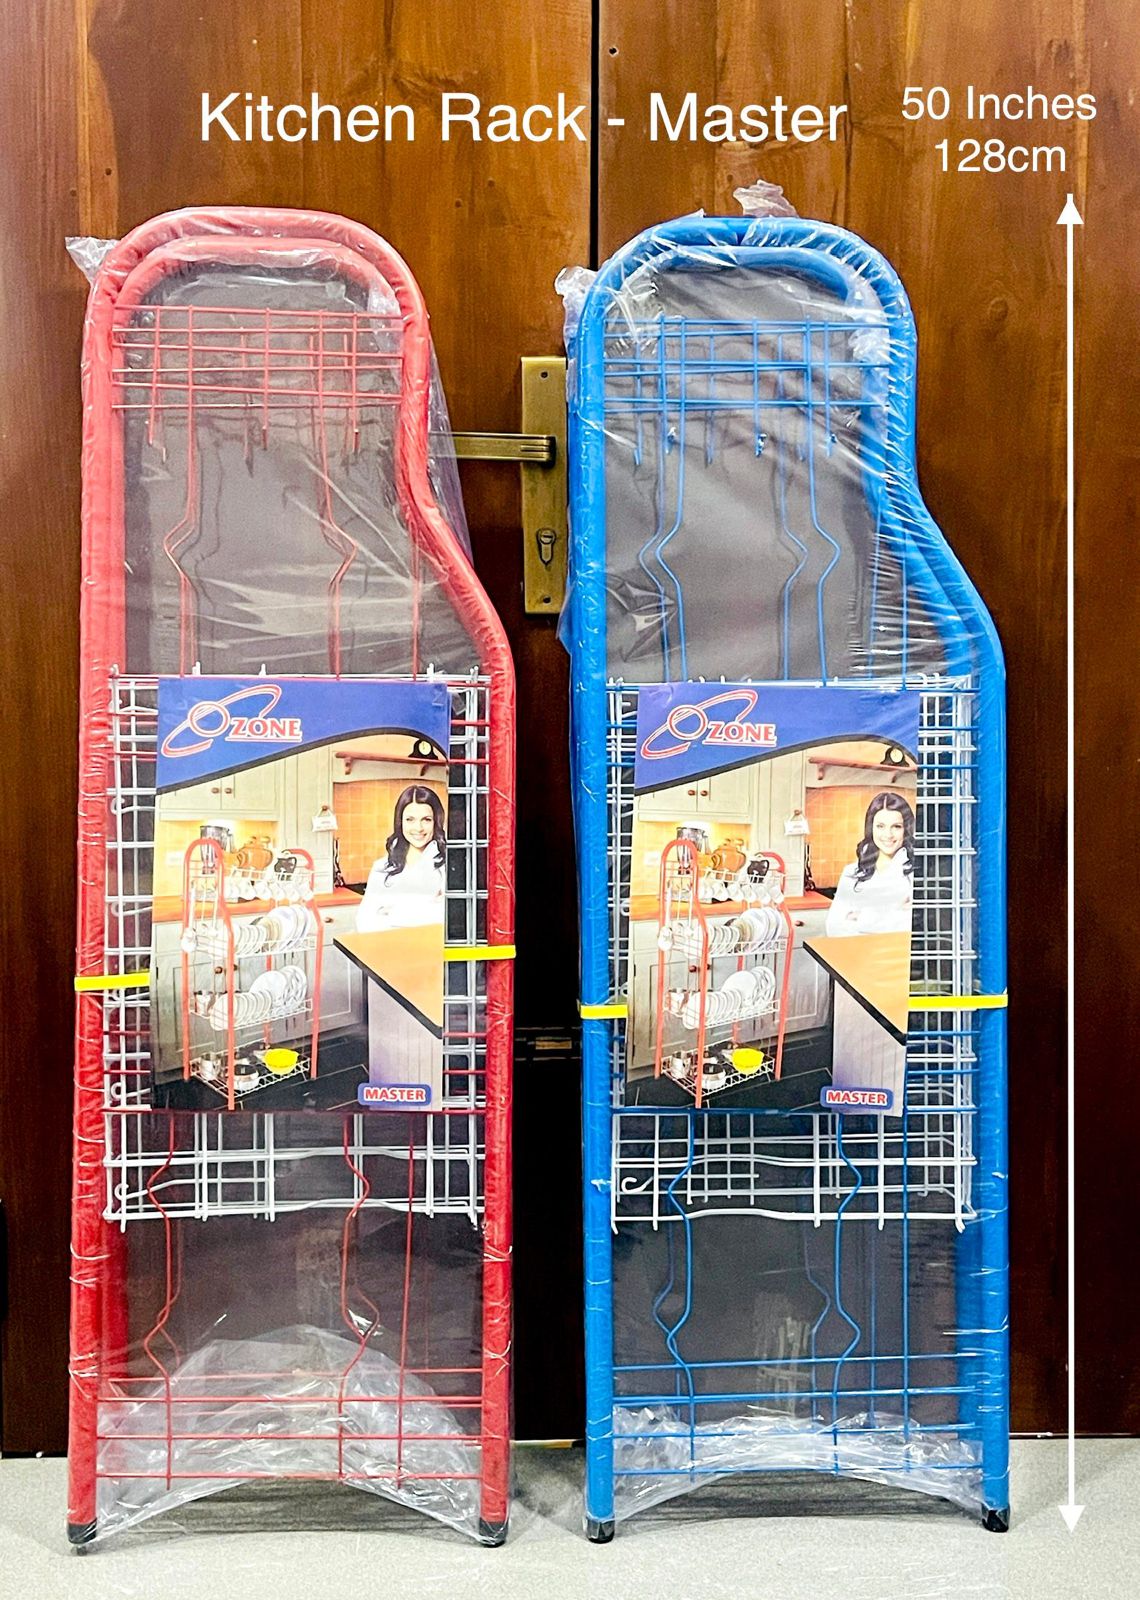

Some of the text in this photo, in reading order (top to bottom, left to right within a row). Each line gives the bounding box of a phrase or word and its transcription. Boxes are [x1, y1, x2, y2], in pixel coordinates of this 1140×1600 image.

[188, 701, 302, 740] OZONE
[667, 704, 776, 744] OZONE
[364, 1087, 426, 1101] MASTER
[826, 1090, 887, 1105] MASTER
